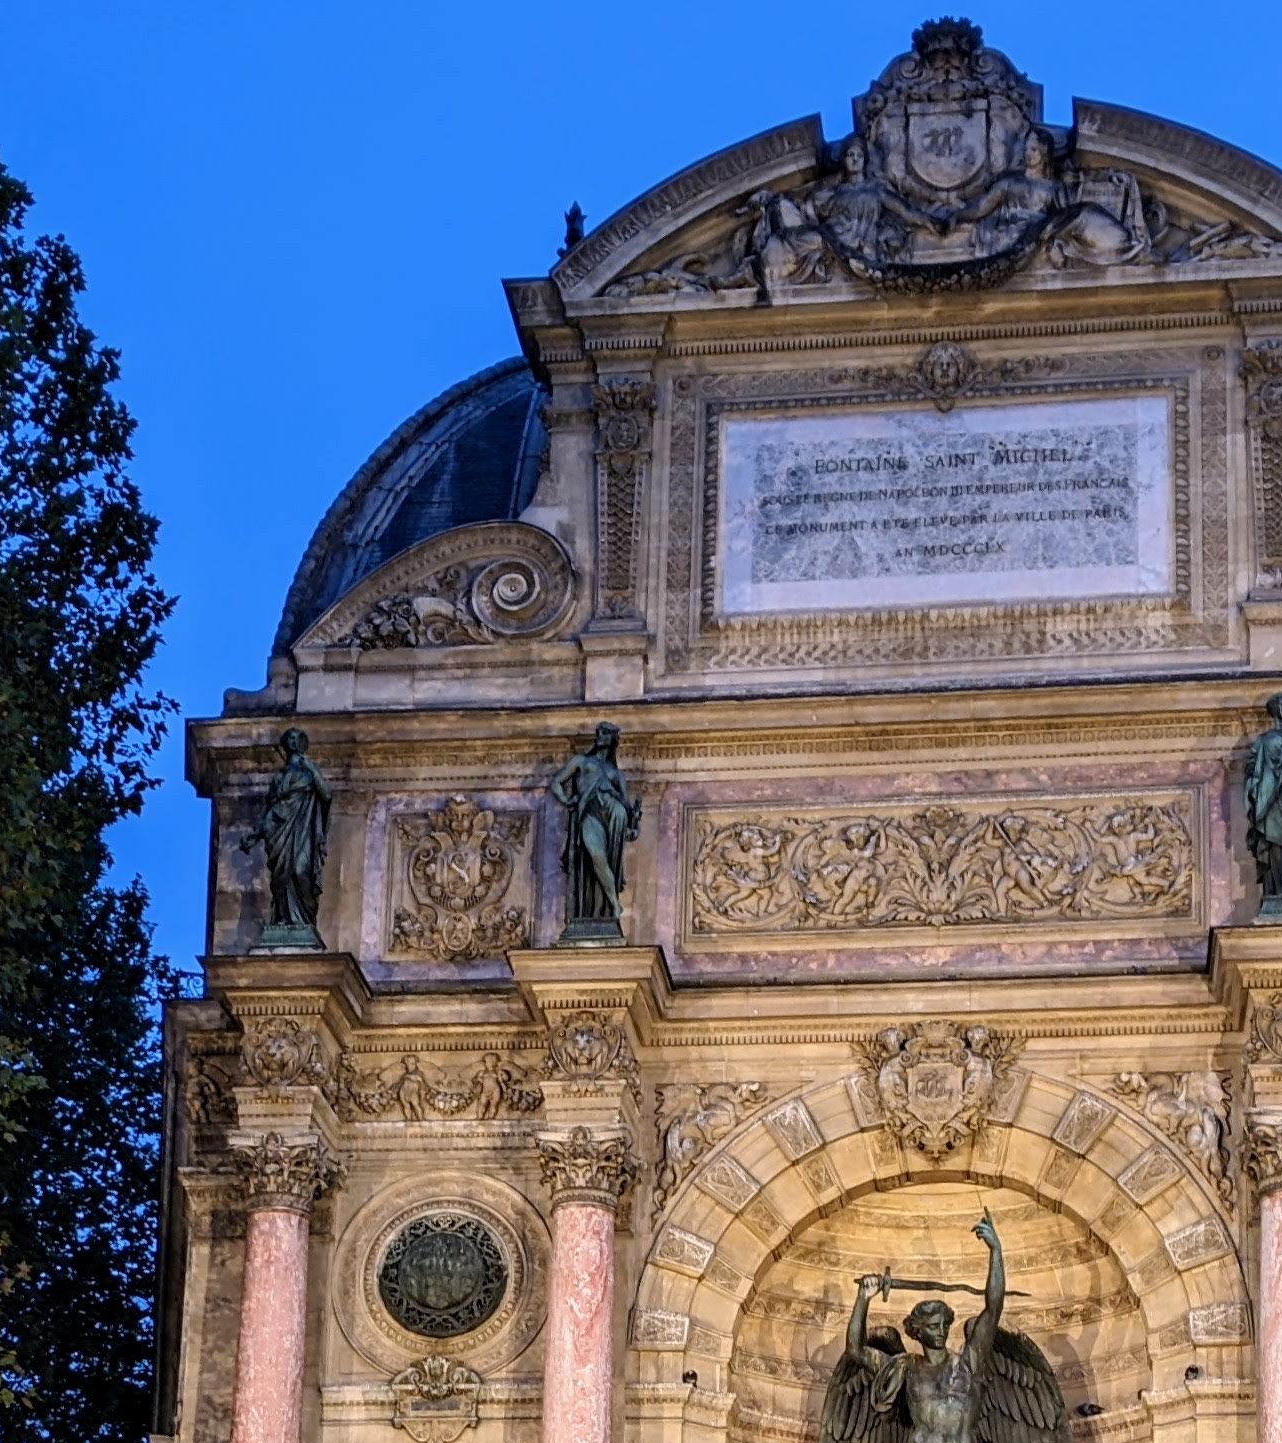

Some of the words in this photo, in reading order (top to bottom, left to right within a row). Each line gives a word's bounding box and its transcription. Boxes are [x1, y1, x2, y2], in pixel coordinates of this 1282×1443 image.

[815, 456, 909, 474] FONTAINE
[924, 453, 977, 469] SAINT
[994, 448, 1073, 465] MICHEL
[966, 481, 1035, 496] EMPEREUR
[1039, 480, 1062, 492] DES
[786, 520, 866, 535] MONUMENT
[1016, 510, 1056, 522] VILLE
[1062, 509, 1077, 520] DE
[1085, 506, 1126, 519] PARIS
